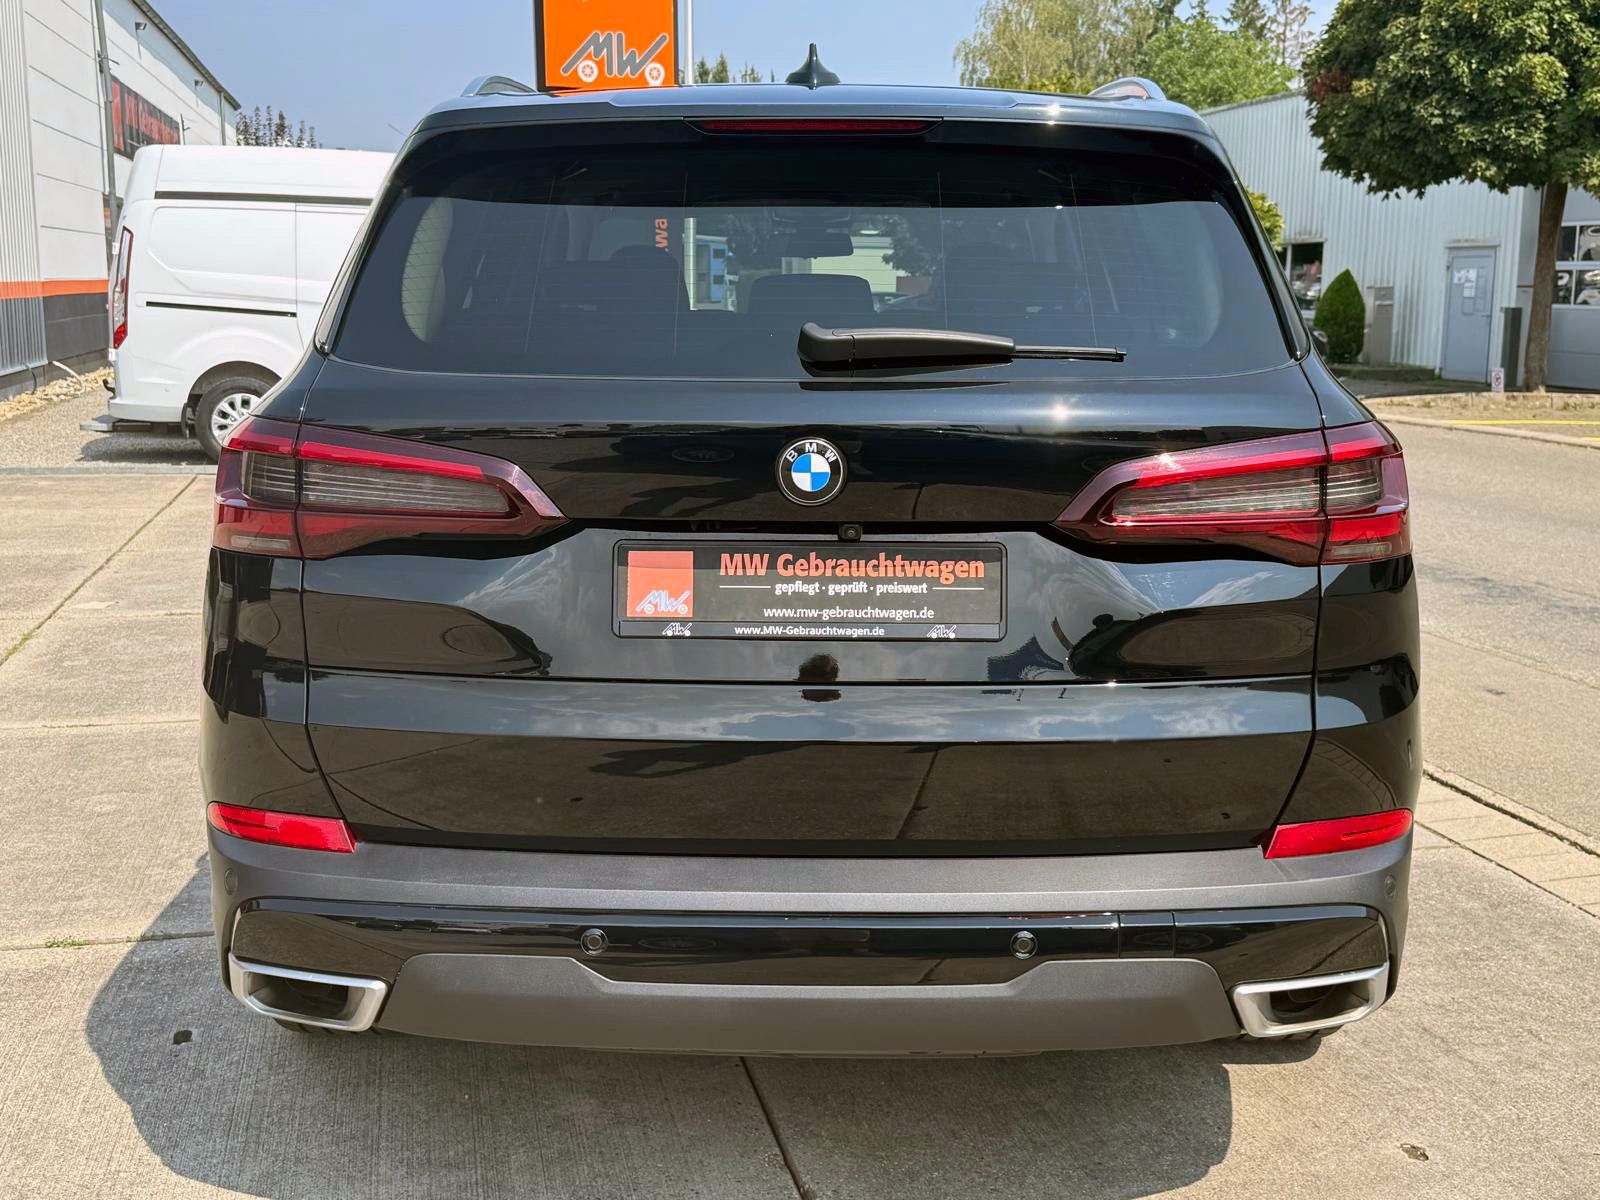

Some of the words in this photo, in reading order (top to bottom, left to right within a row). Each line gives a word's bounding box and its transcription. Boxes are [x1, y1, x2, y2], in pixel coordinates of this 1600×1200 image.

[560, 31, 670, 78] MW
[785, 442, 837, 463] BMW
[719, 553, 770, 577] MW
[776, 551, 985, 585] Gebrauchtwagen
[774, 581, 820, 596] gepflegt
[827, 581, 868, 596] geprüft
[876, 581, 928, 597] preiswert
[763, 606, 935, 621] www.mw-gebrauchtwagen.de
[734, 625, 885, 638] www.MW-Gebrauchtwagen.de
